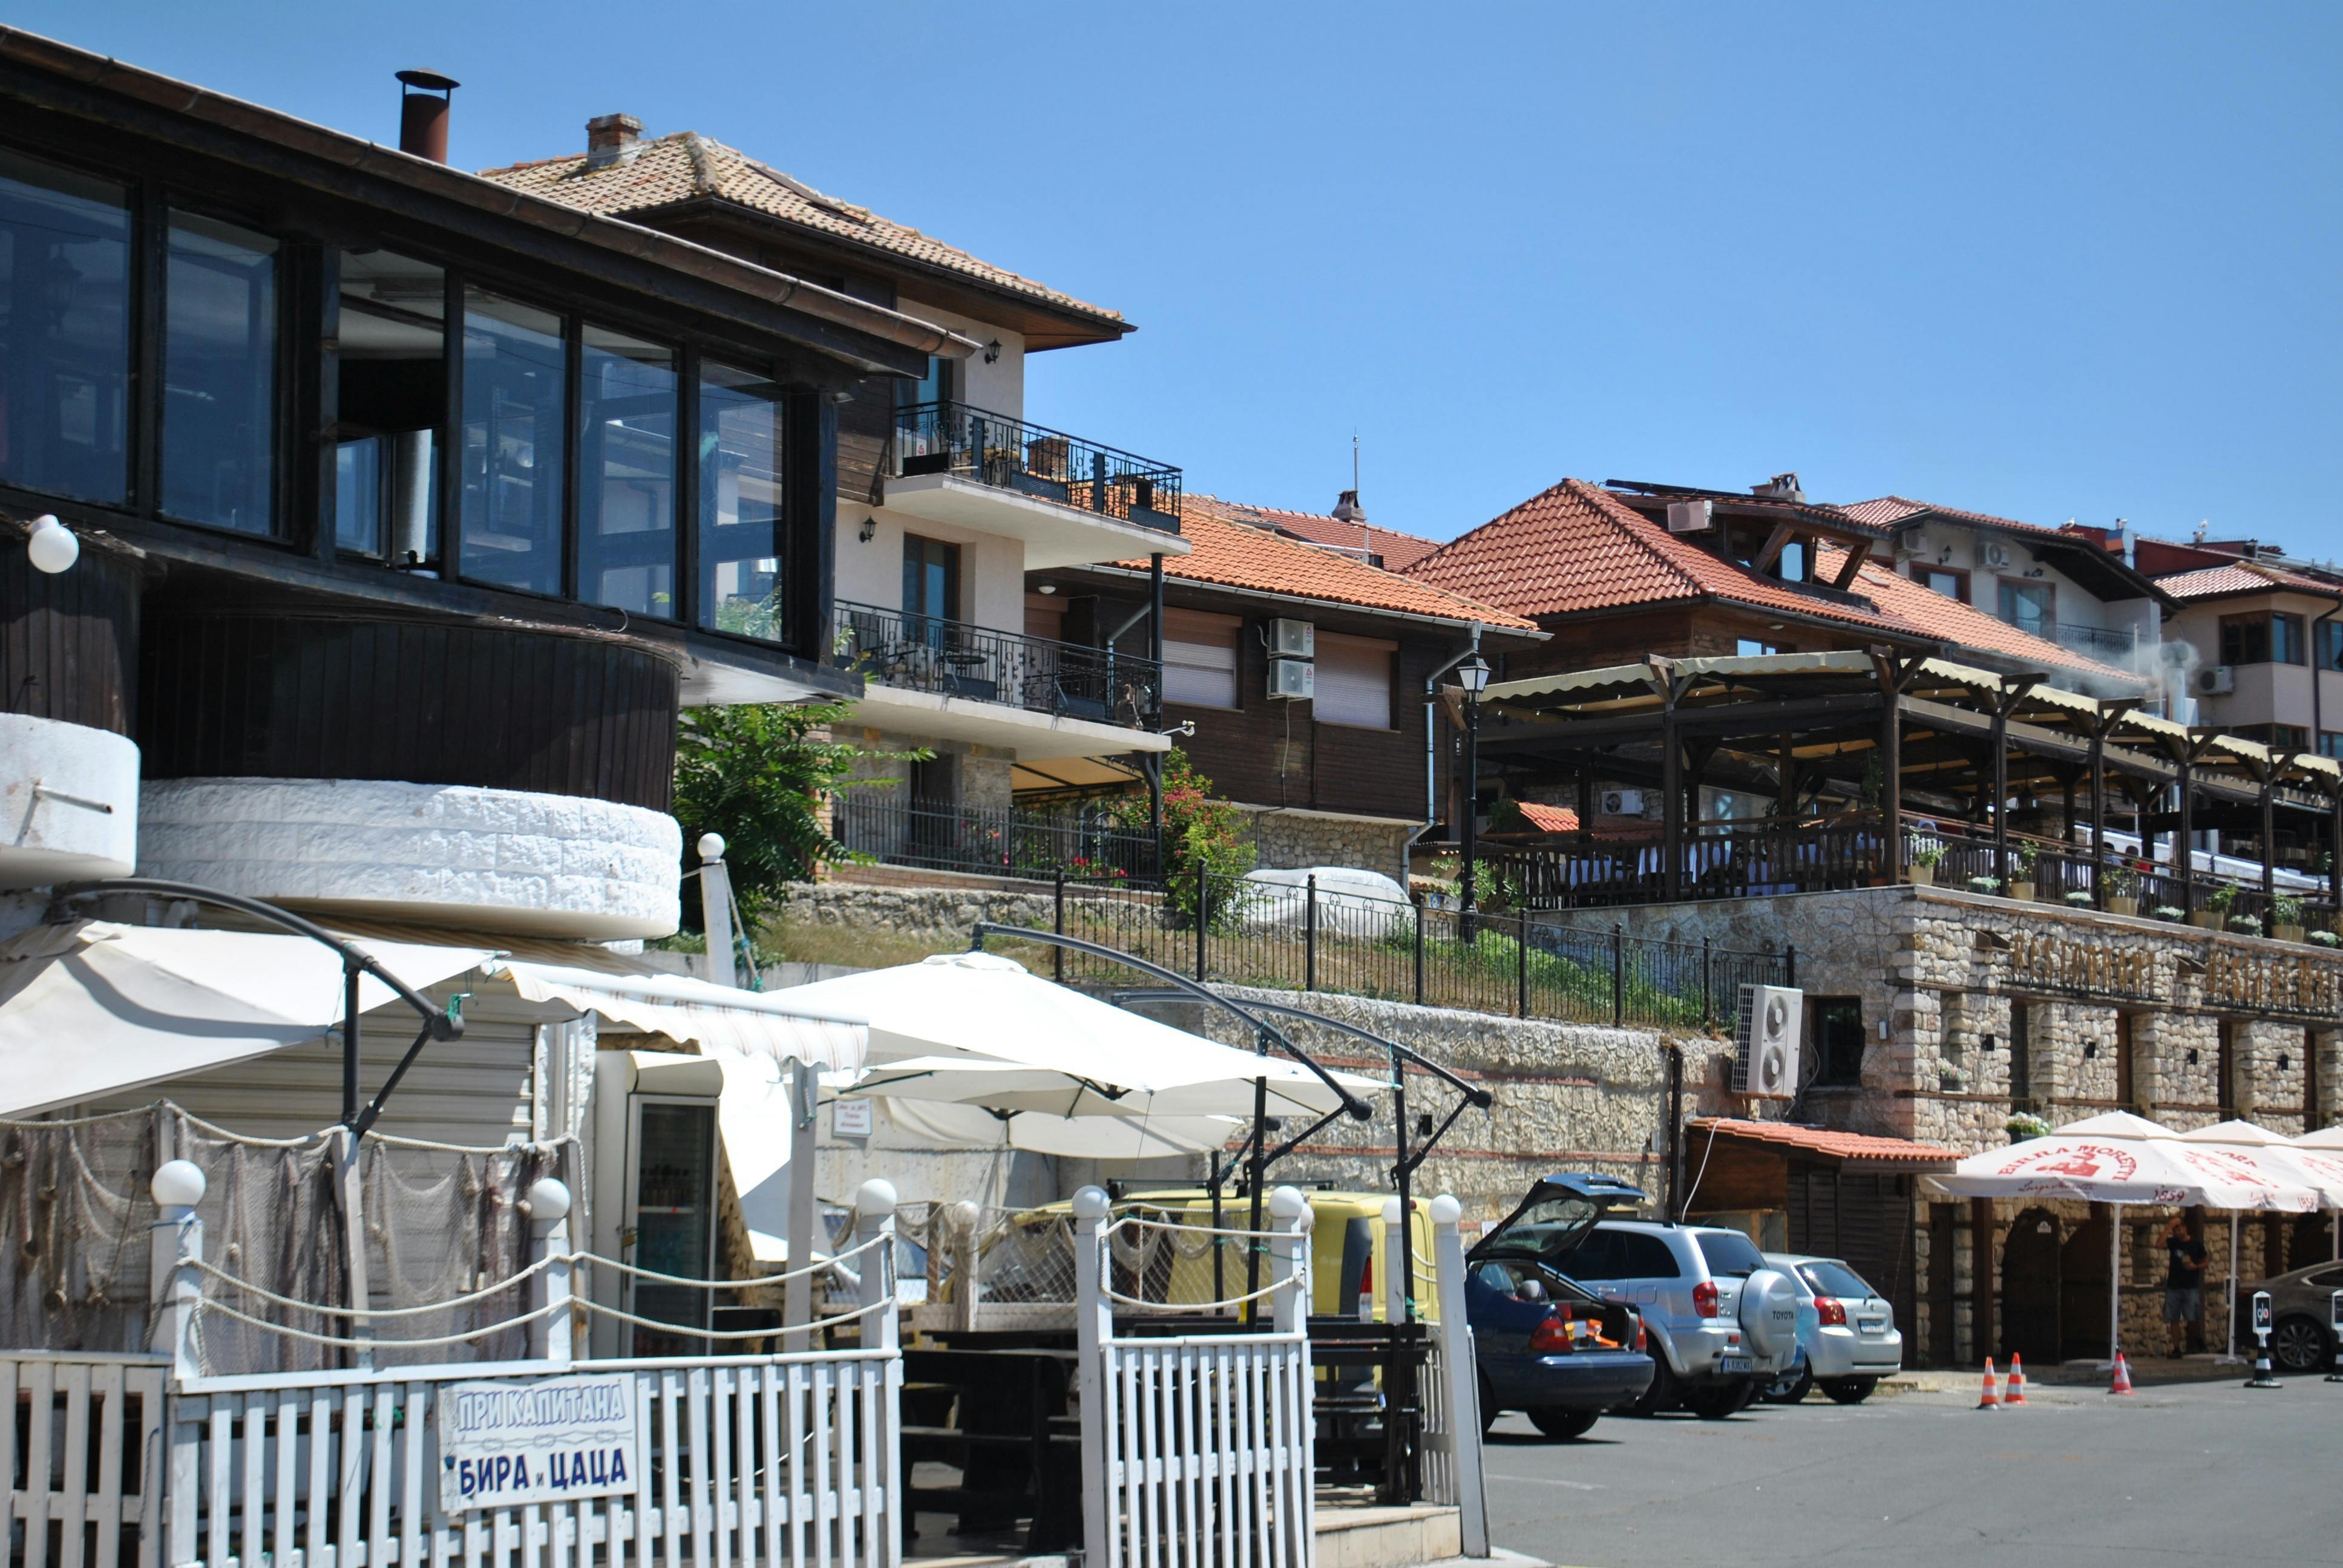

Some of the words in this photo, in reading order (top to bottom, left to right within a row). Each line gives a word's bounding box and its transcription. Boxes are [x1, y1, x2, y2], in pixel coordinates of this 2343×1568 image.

[1997, 1146, 2068, 1175] BIRRA
[2078, 1145, 2137, 1180] MORETTI
[2154, 1189, 2185, 1201] 1859
[1772, 1310, 1794, 1321] TOYOTA
[2257, 1302, 2269, 1322] glo
[458, 1390, 503, 1432] ПРИ
[506, 1383, 626, 1428] КАПИТАНА
[460, 1454, 530, 1495] БИРА
[549, 1448, 628, 1491] ЦАЦА
